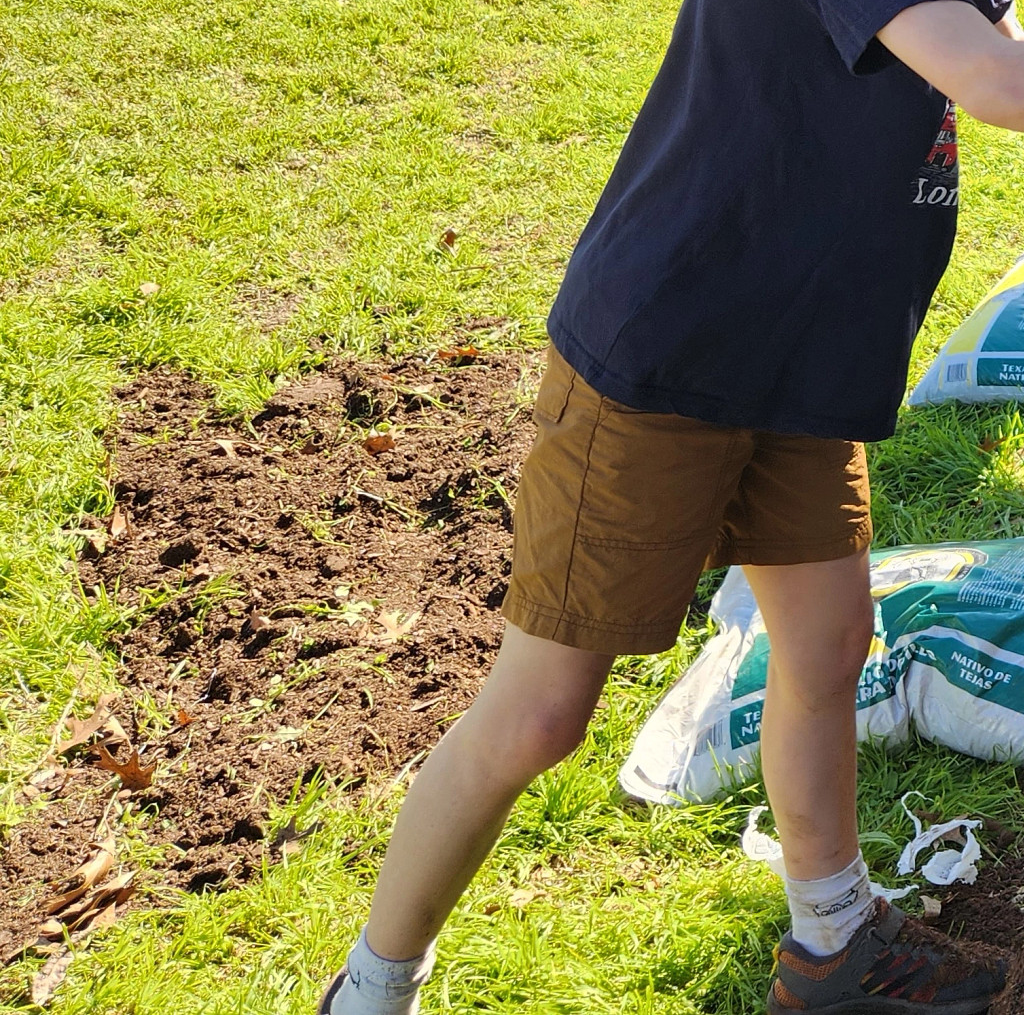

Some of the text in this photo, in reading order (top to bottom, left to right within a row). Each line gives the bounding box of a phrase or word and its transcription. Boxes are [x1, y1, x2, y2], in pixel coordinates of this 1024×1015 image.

[913, 178, 958, 206] Lon
[950, 651, 1013, 684] NATIVO DE
[959, 668, 993, 690] TEJAS
